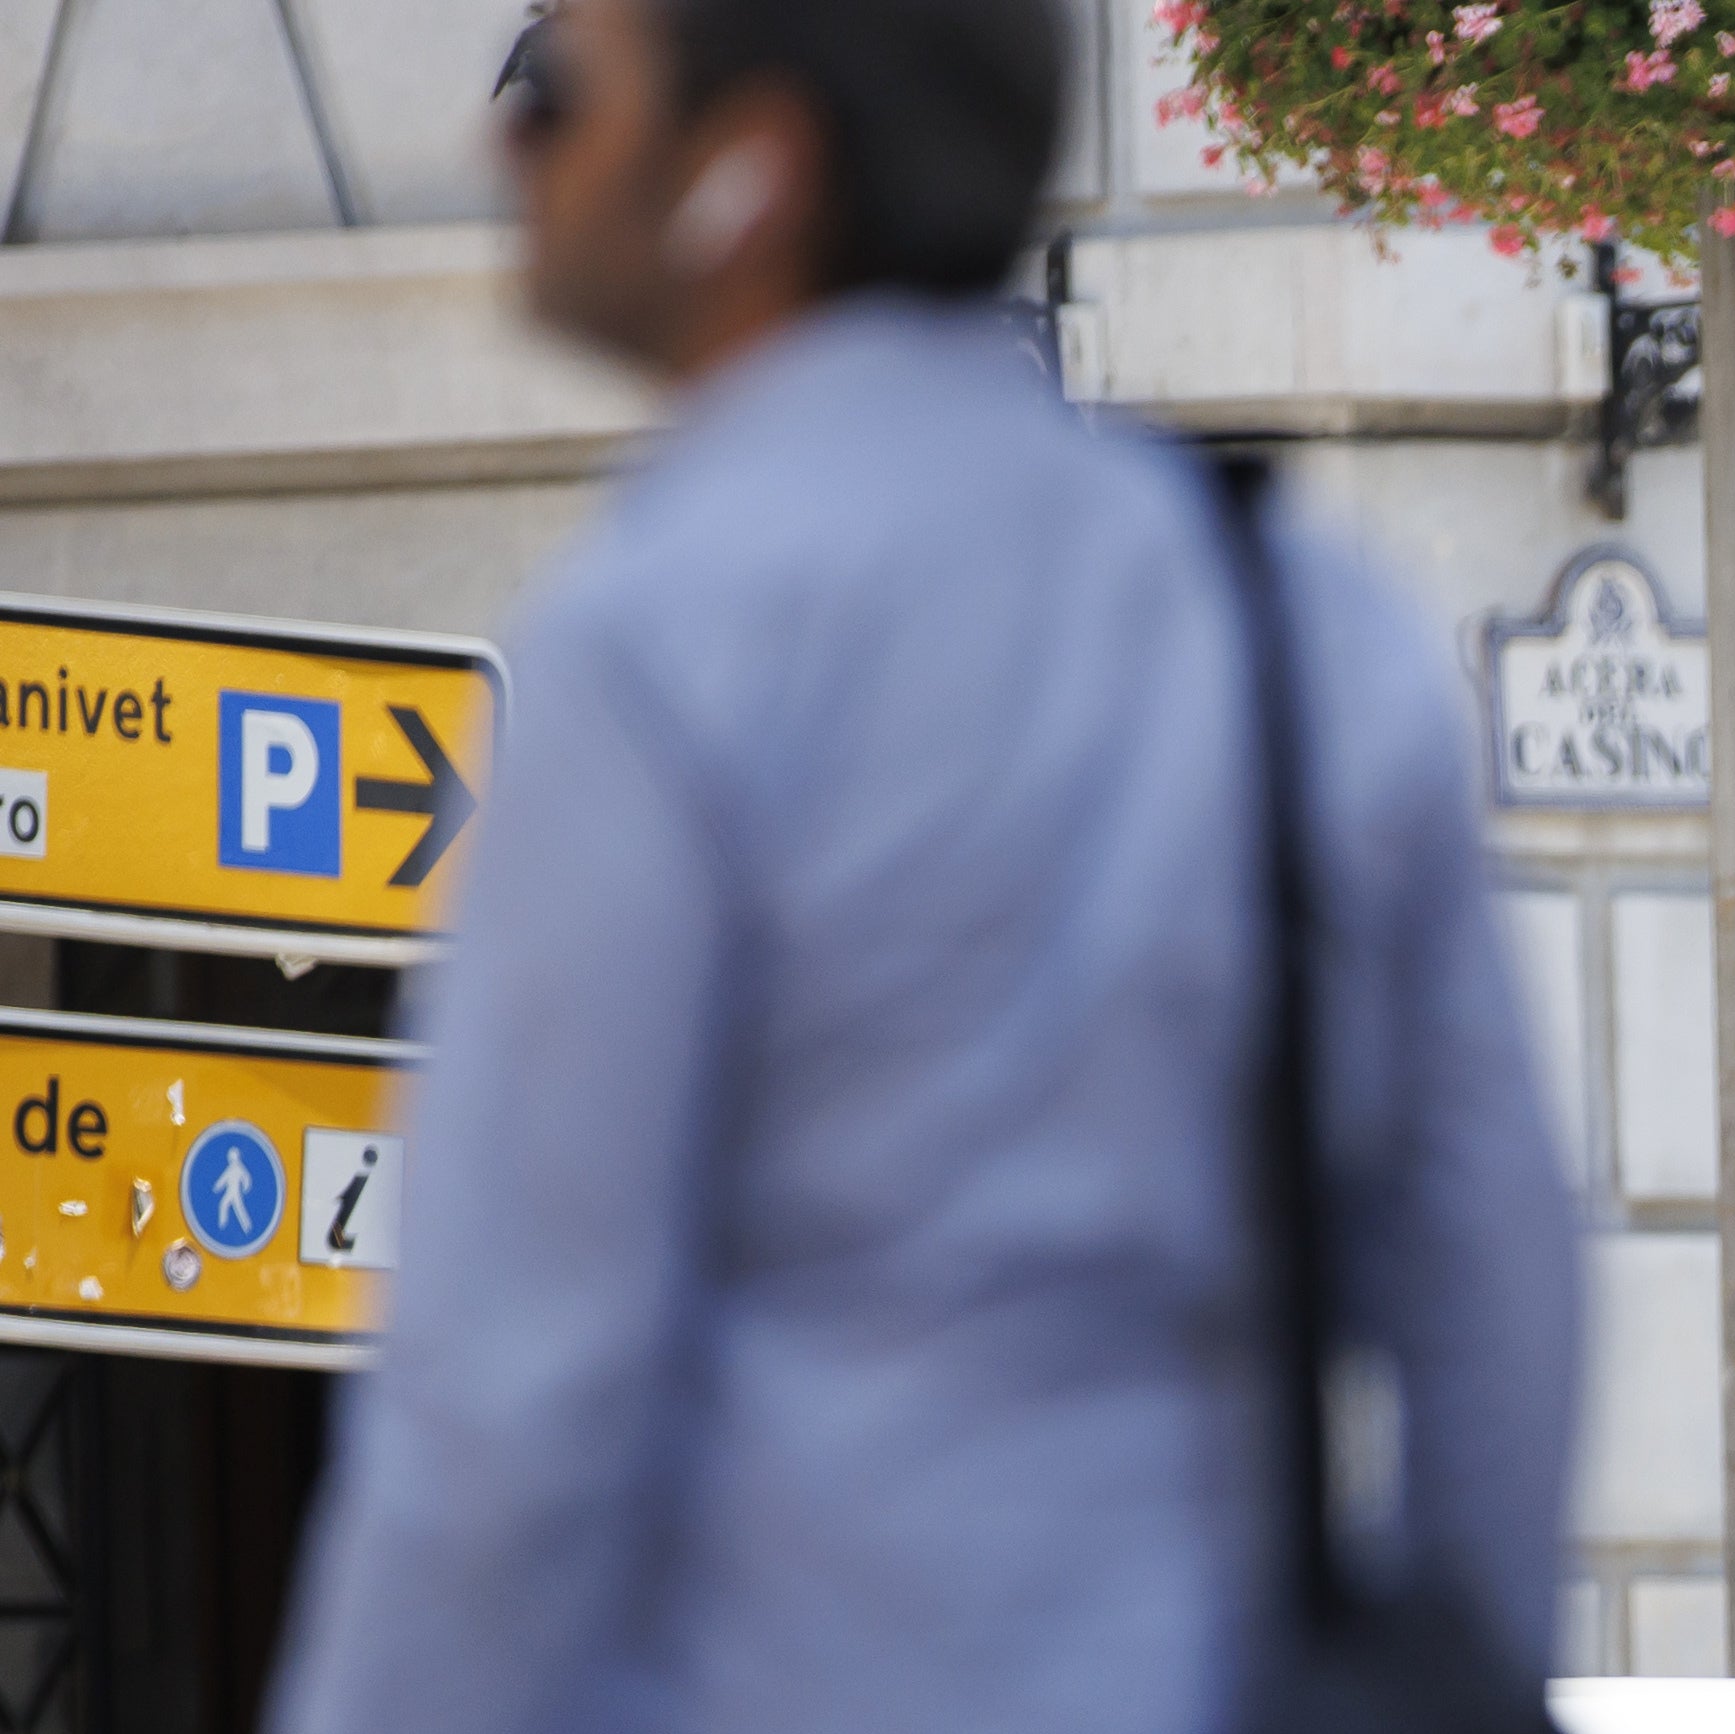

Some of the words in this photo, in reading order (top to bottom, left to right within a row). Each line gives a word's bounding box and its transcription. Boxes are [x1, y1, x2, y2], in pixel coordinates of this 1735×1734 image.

[1540, 653, 1683, 698] ACERA
[241, 708, 320, 853] P
[14, 1074, 108, 1160] de
